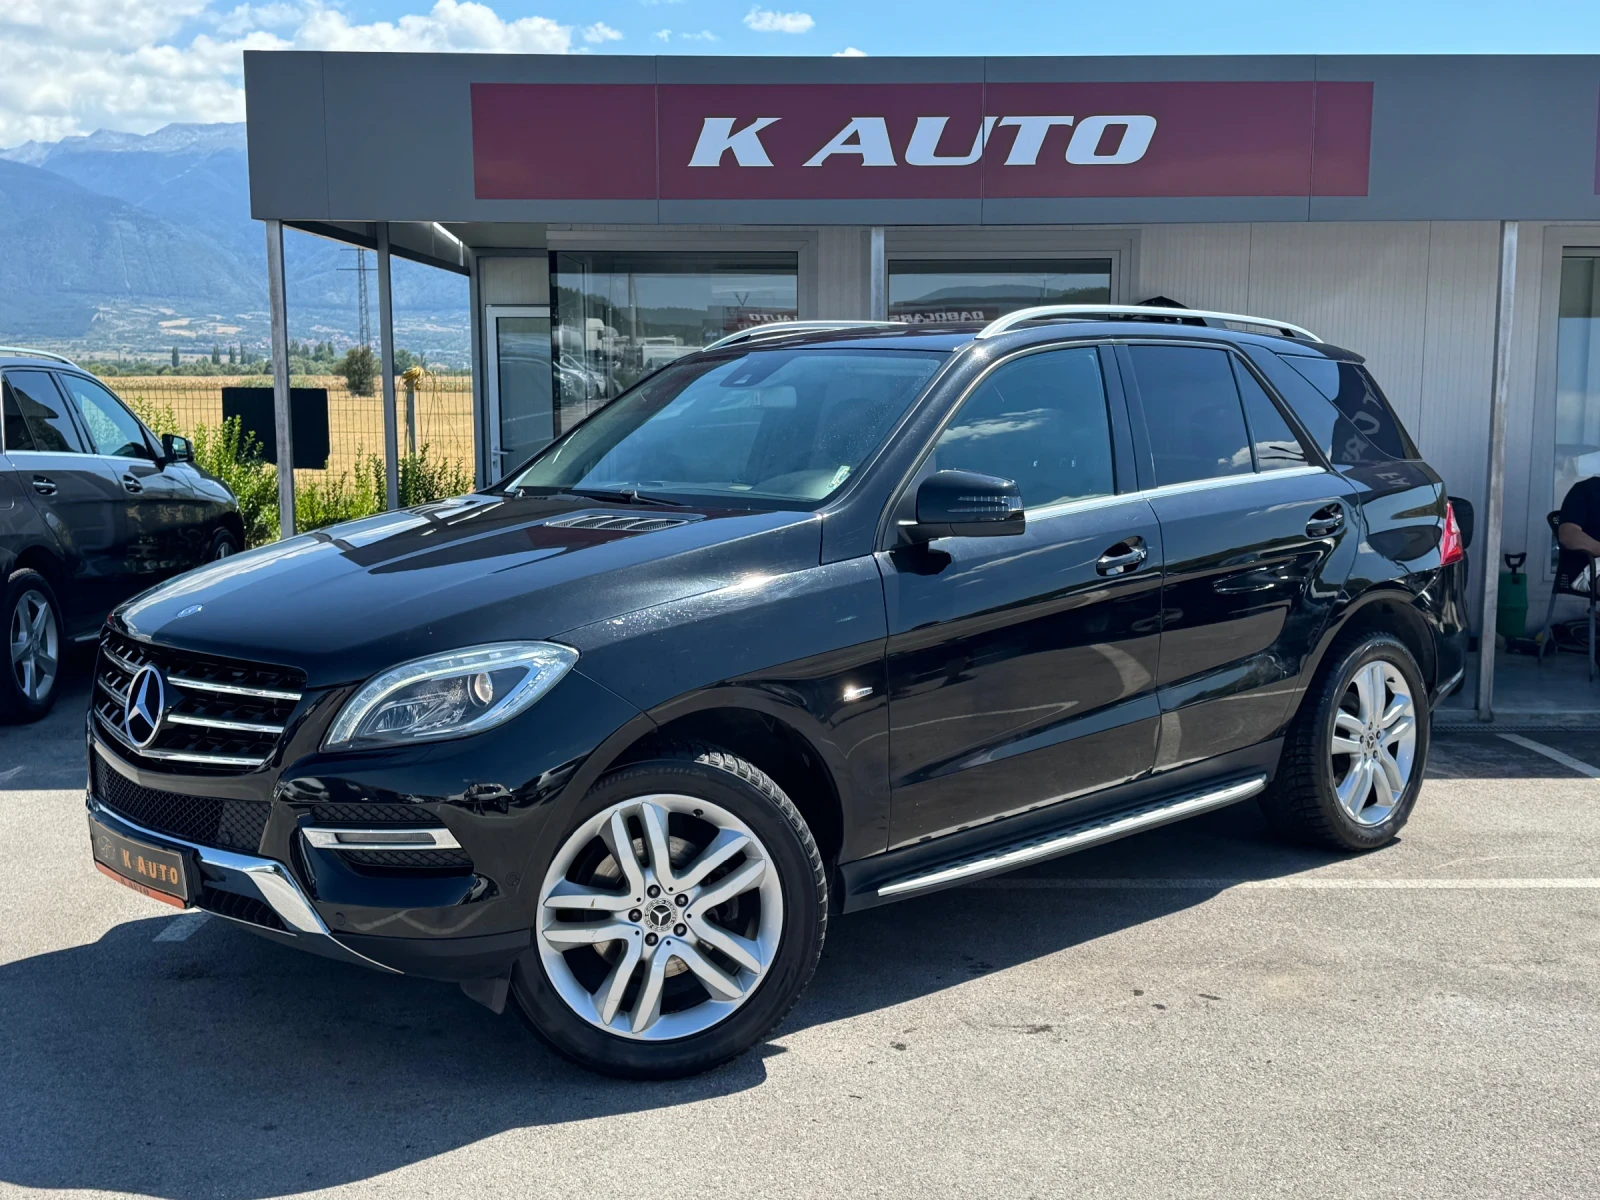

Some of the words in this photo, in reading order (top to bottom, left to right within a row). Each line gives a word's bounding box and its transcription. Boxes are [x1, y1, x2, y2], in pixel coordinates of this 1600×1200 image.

[687, 117, 783, 167] K
[802, 115, 1157, 167] AUTO
[122, 848, 132, 869] K
[138, 855, 178, 885] AUTO
